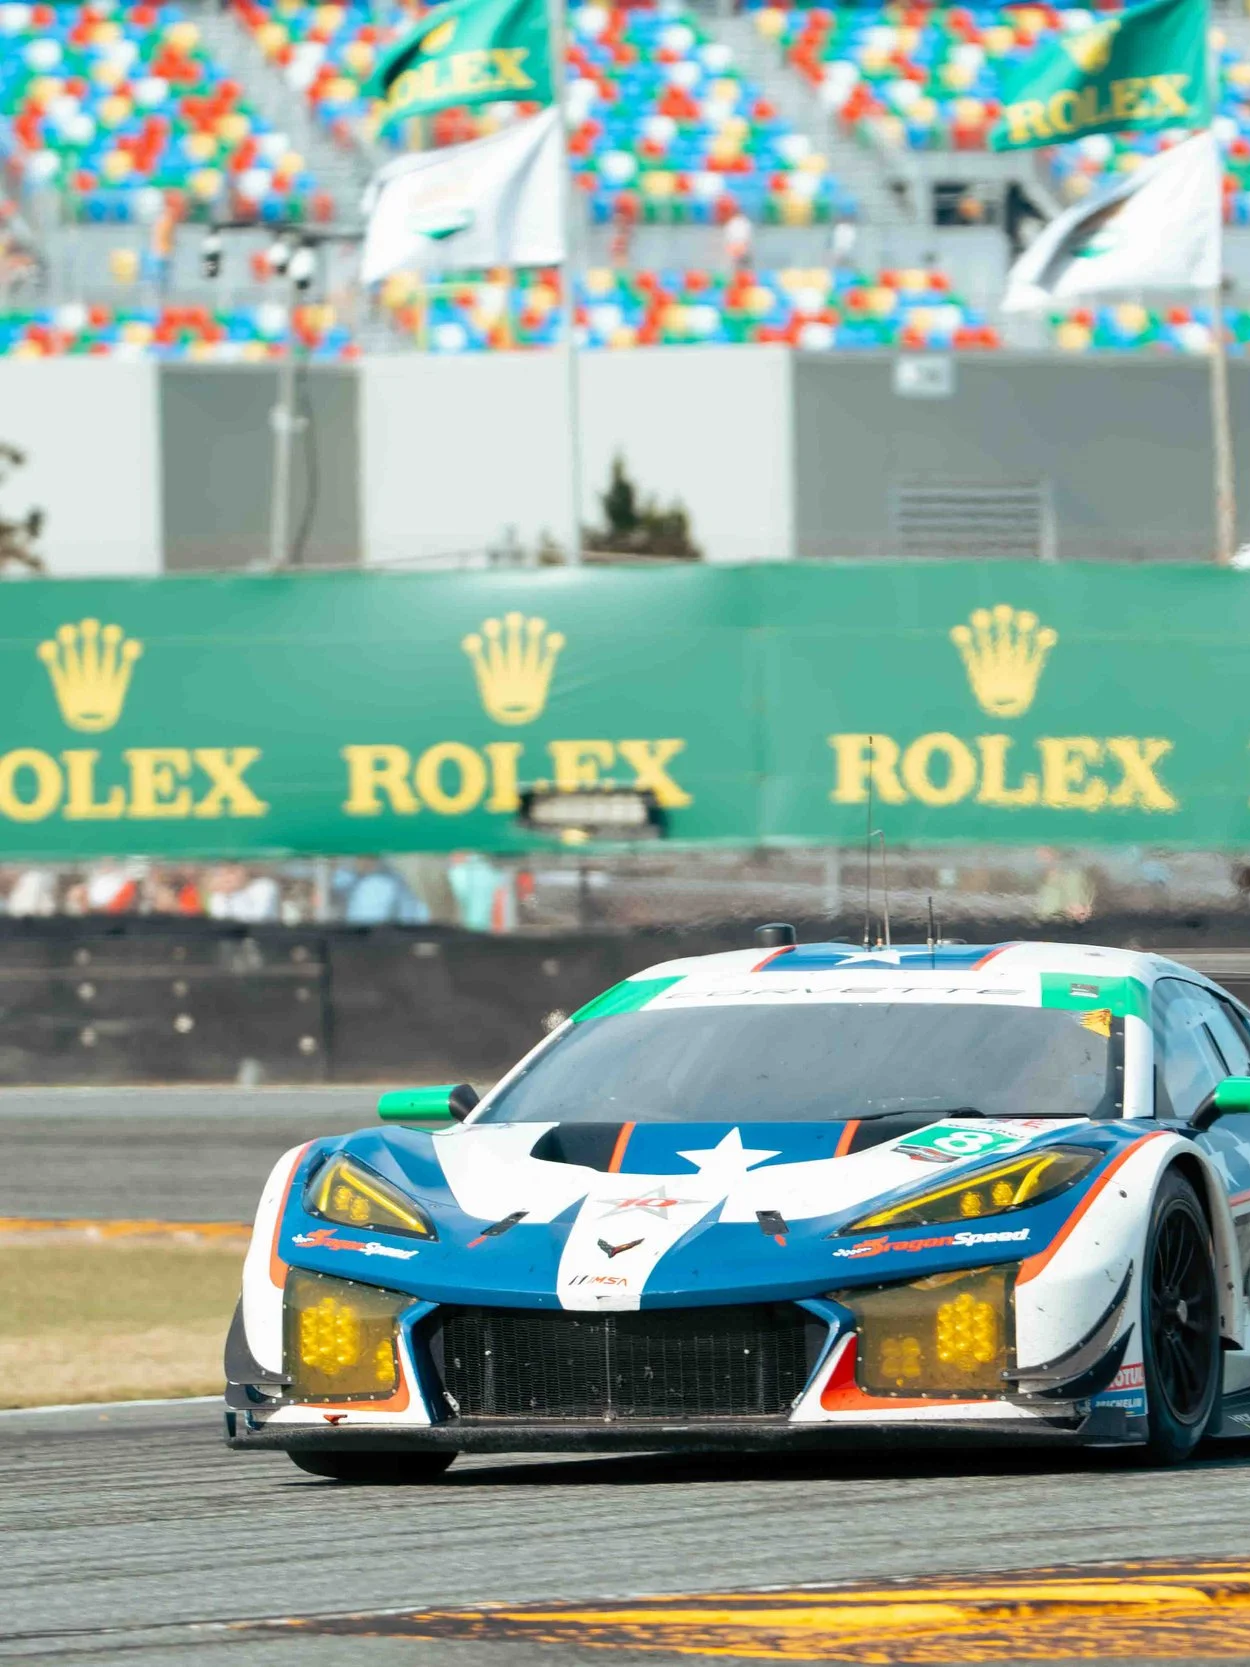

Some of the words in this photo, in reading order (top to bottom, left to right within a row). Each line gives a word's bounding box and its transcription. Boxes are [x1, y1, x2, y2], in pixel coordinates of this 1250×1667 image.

[386, 46, 536, 111] OLEX
[1006, 73, 1188, 143] ROLEX
[0, 746, 267, 821] OLEX
[829, 732, 1179, 813] ROLEX
[665, 986, 1026, 1000] CORVETTE
